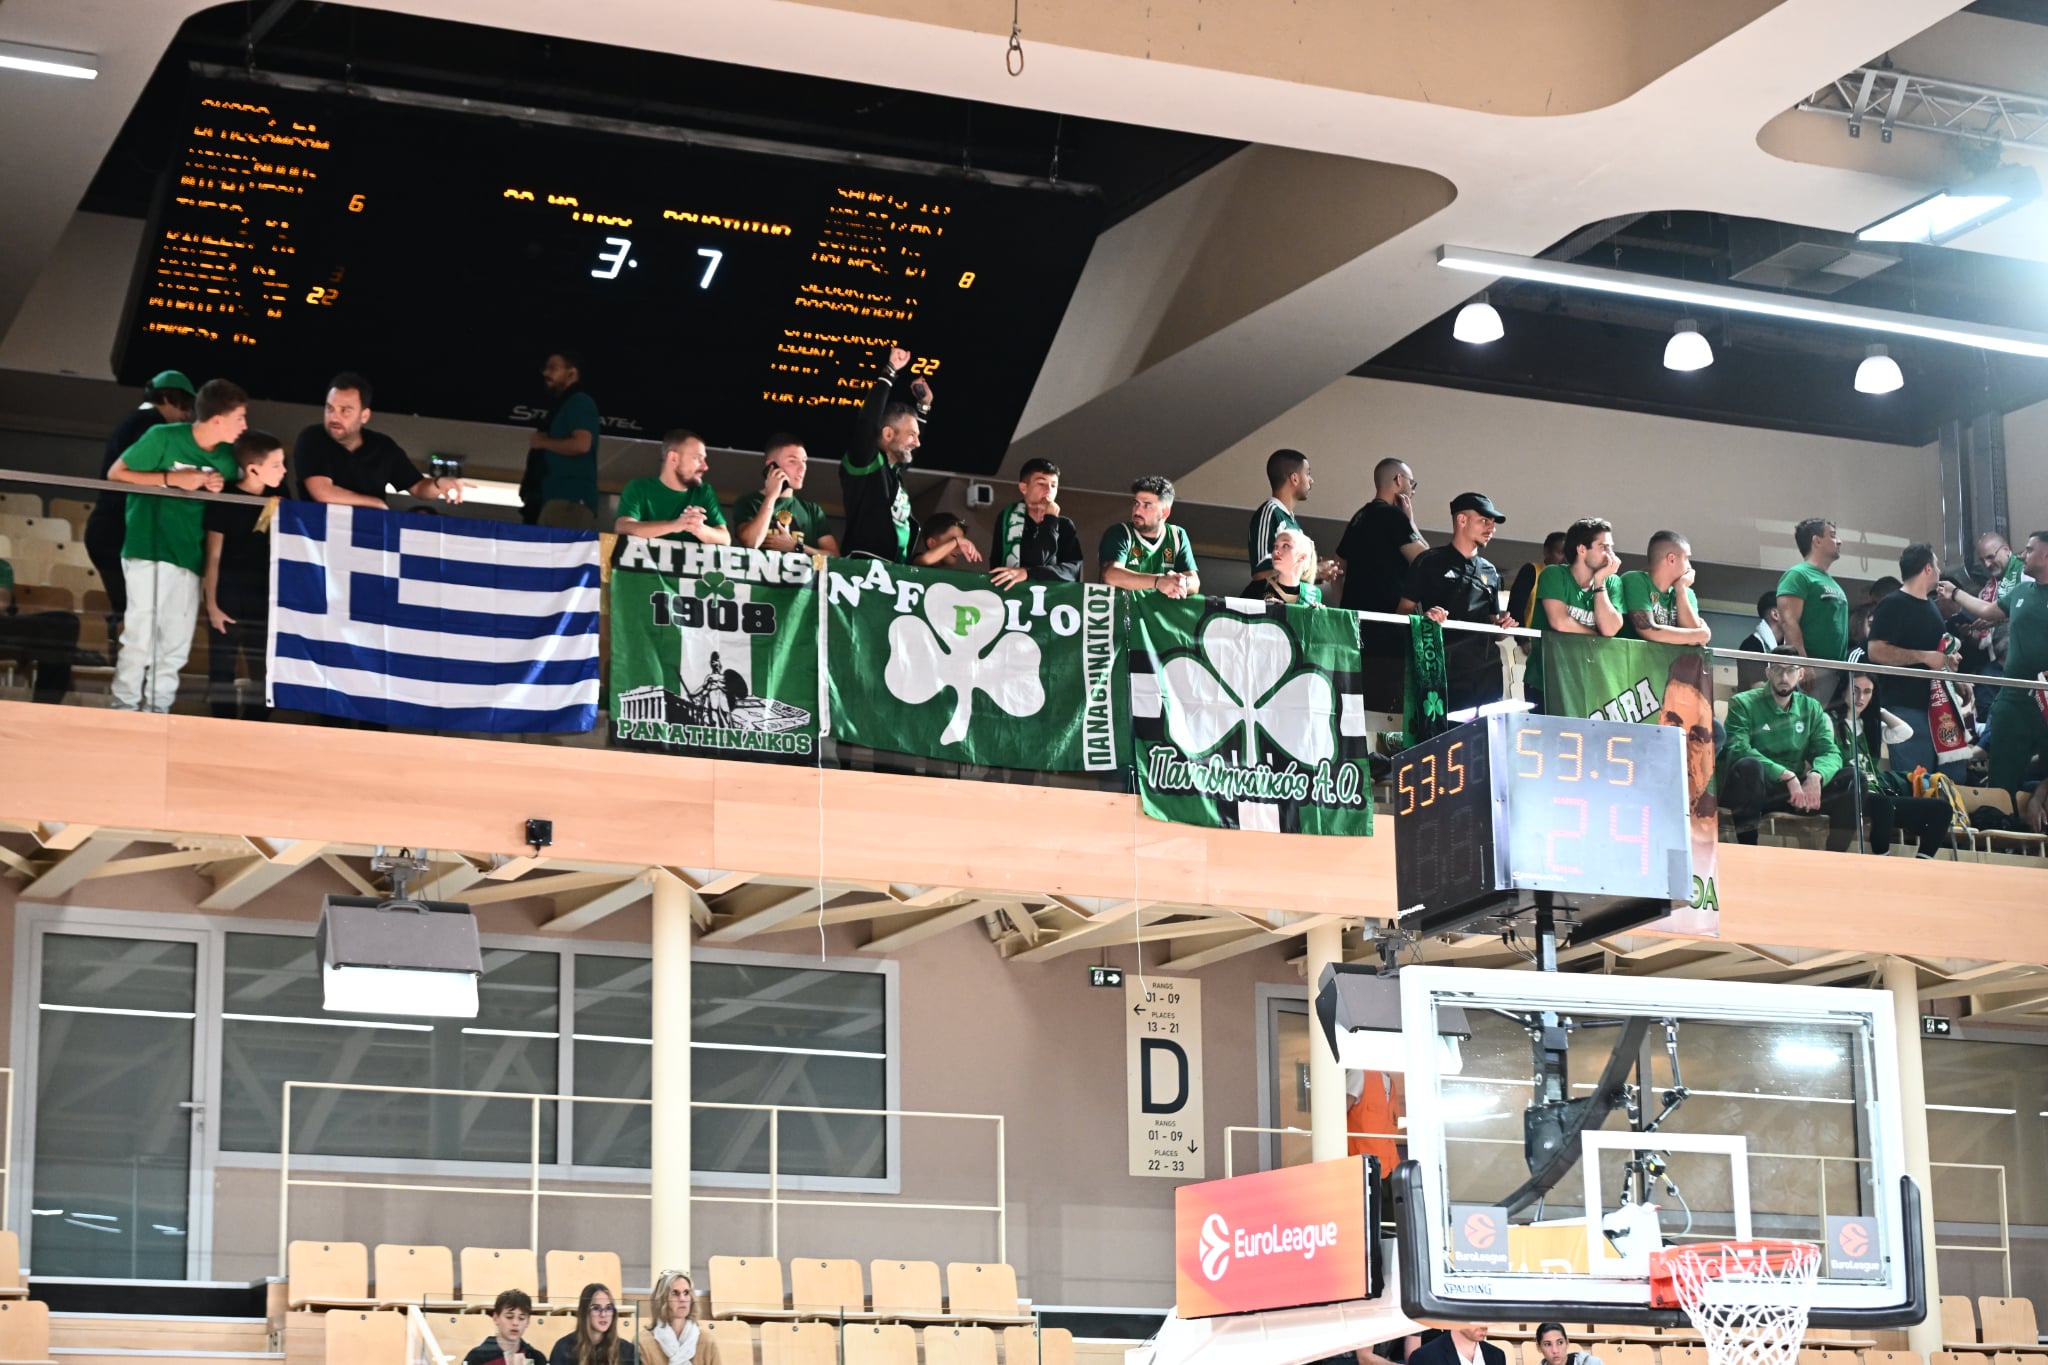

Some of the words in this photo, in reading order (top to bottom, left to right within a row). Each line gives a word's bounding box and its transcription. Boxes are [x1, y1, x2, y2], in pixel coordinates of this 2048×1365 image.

[348, 194, 366, 213] 6
[697, 247, 724, 289] 7
[958, 271, 976, 289] 8
[910, 357, 941, 376] 22
[618, 536, 815, 586] ATHENS
[827, 559, 1081, 637] NAFPLIO
[650, 590, 777, 634] 1908
[617, 717, 813, 755] PANATHINAIKOS
[1516, 728, 1635, 786] 53.5
[1397, 741, 1466, 816] 53.5
[1547, 796, 1650, 876] 24
[1152, 982, 1173, 990] RANGS
[1146, 992, 1158, 1003] 01
[1167, 994, 1180, 1004] 09
[1151, 1011, 1175, 1019] PLACES
[1147, 1021, 1158, 1032] 13
[1169, 1023, 1179, 1033] 21
[1140, 1037, 1189, 1114] D
[1155, 1119, 1176, 1127] RANGS
[1148, 1130, 1159, 1141] 01
[1170, 1131, 1183, 1142] 09
[1154, 1149, 1178, 1157] PLACES
[1148, 1159, 1160, 1171] 22
[1172, 1160, 1185, 1171] 33
[1234, 1221, 1338, 1260] EuroLeague
[1443, 1283, 1492, 1295] SPALDING
